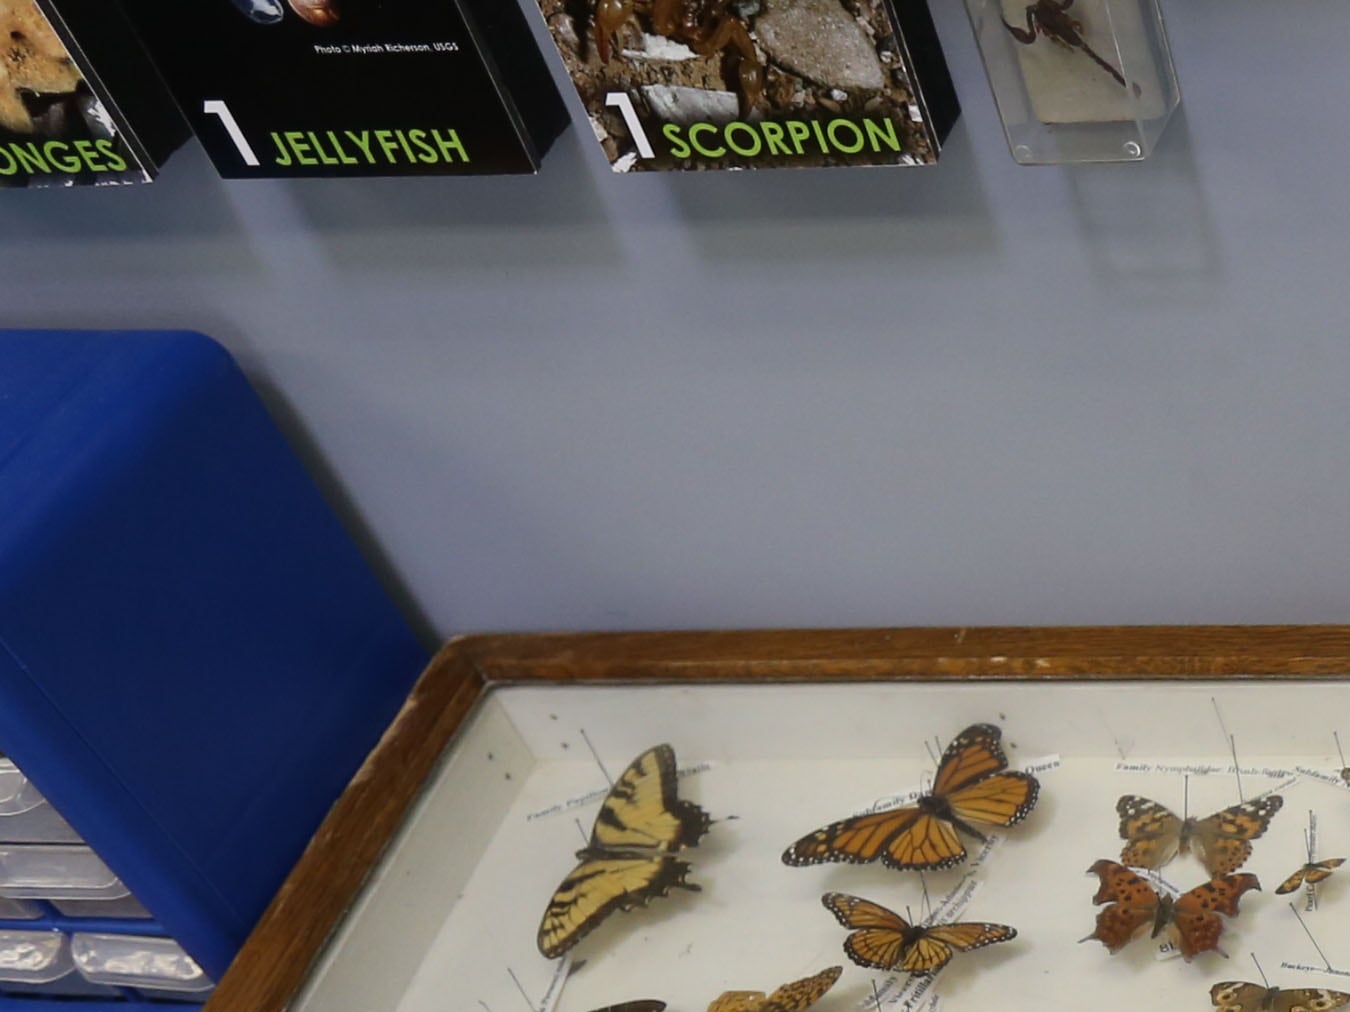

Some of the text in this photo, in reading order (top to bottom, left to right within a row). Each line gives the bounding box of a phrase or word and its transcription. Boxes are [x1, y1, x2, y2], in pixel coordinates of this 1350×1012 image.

[314, 44, 341, 54] Photo
[433, 42, 459, 51] USGS
[203, 100, 260, 166] 1
[606, 93, 655, 159] 1
[662, 117, 902, 160] SCORPION
[271, 129, 470, 168] JELLYFISH
